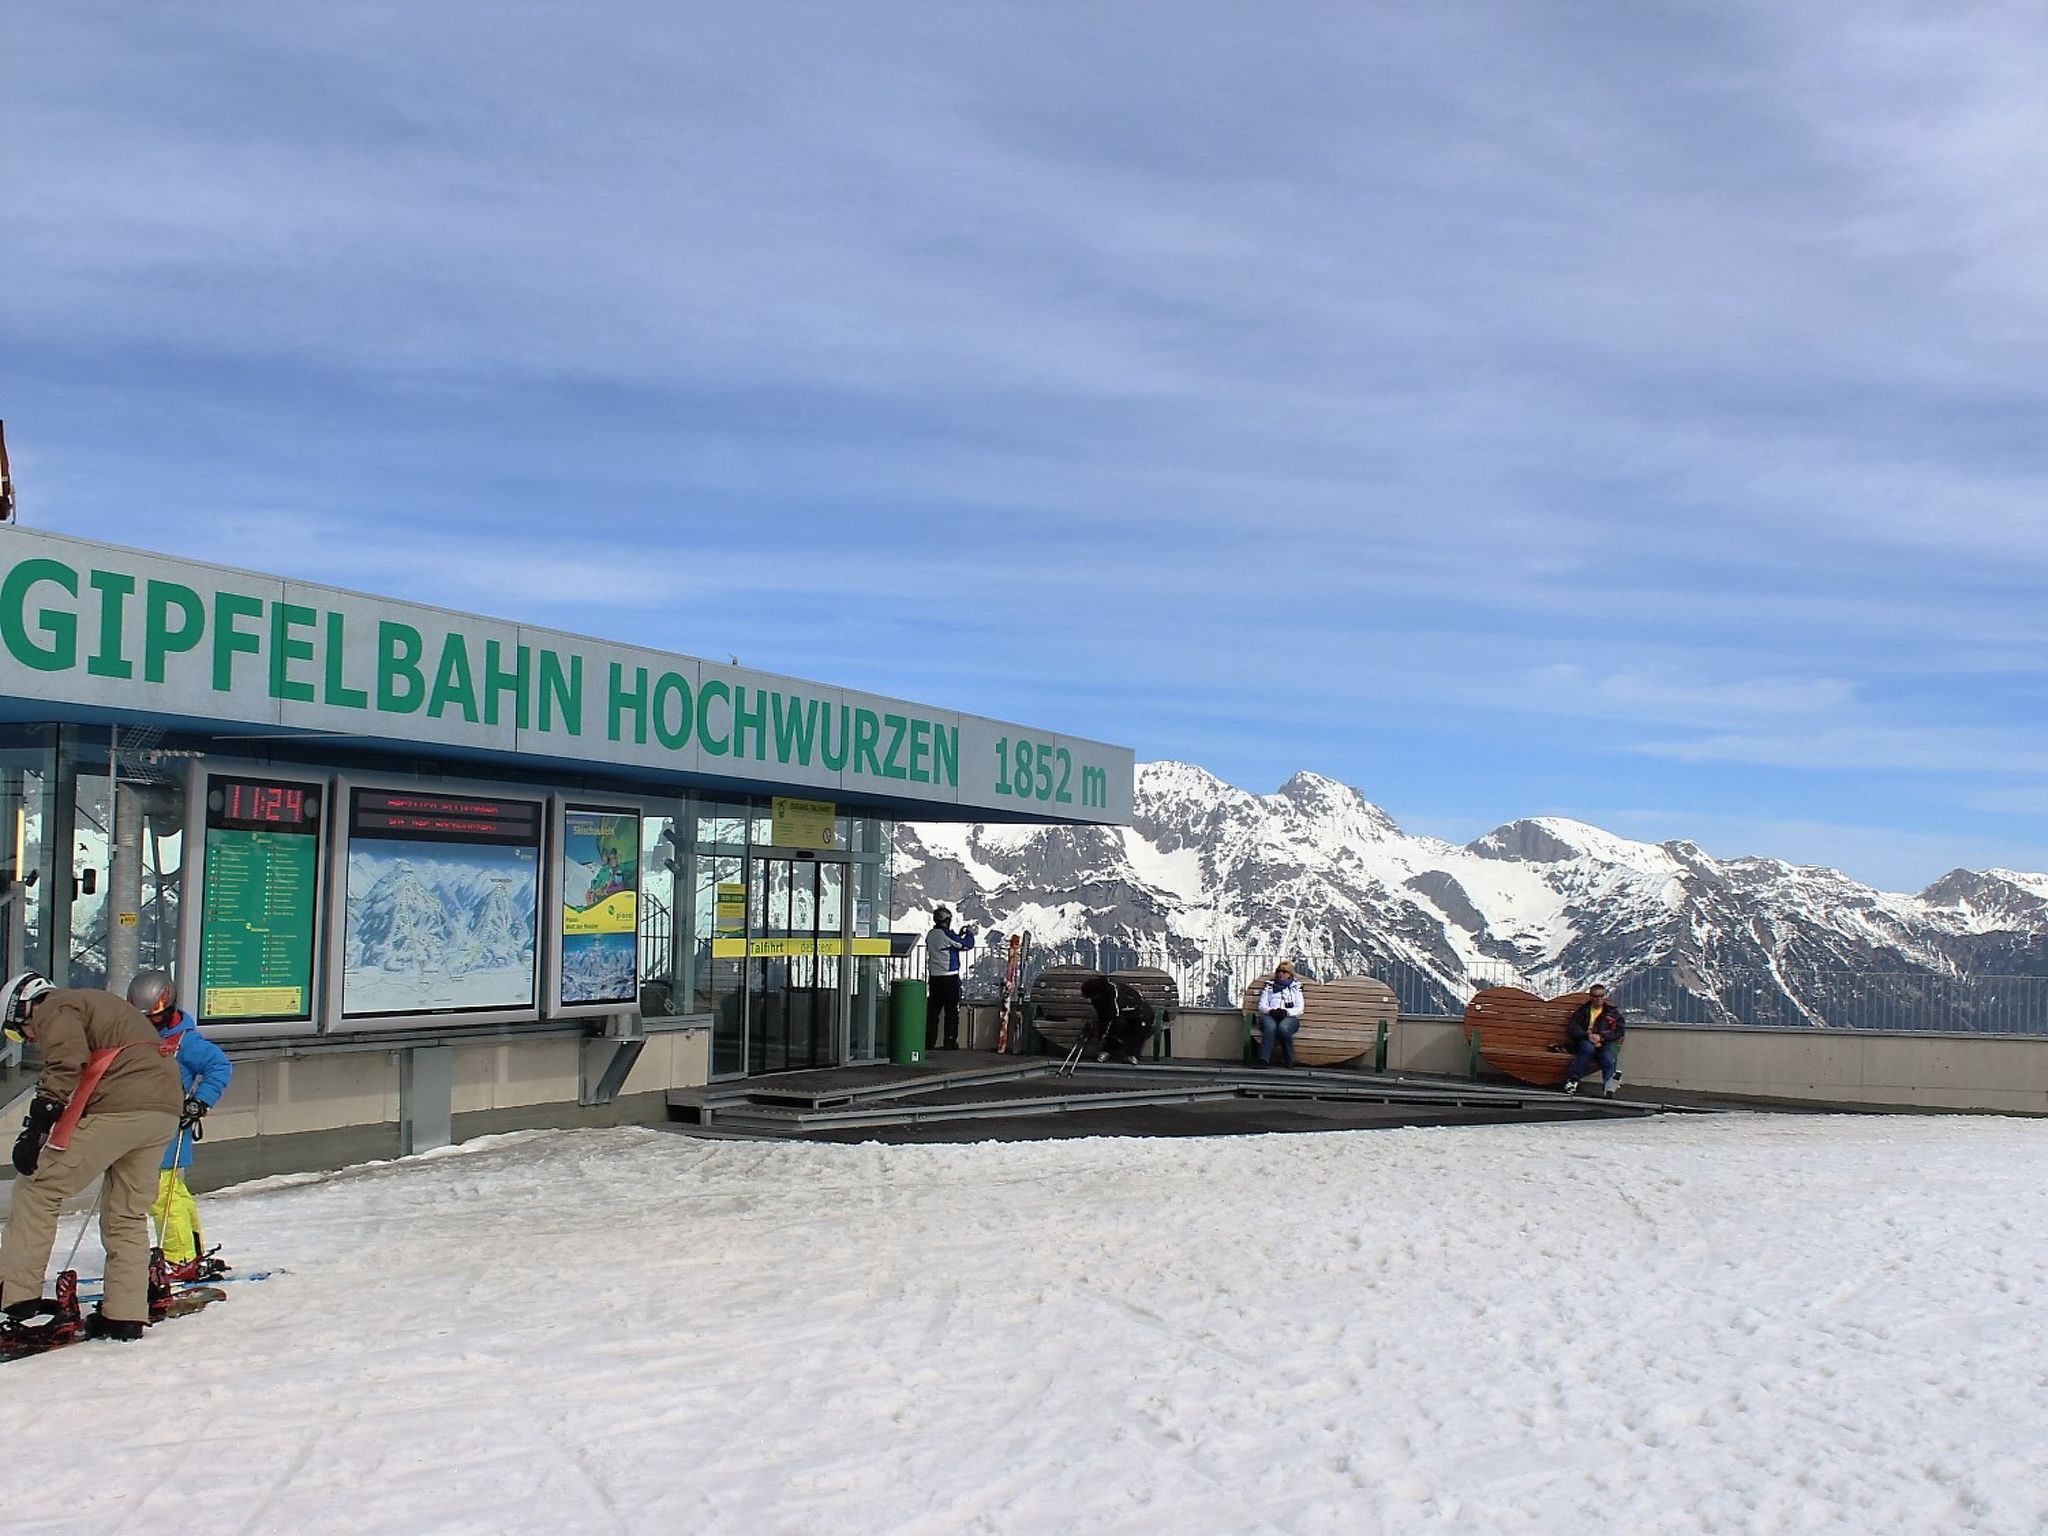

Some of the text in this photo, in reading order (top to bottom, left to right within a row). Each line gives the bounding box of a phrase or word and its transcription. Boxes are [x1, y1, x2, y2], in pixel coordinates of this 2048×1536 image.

[0, 558, 1107, 808] GIPFELBAHN HOCHWURZEN 1852 m
[232, 784, 303, 823] 11:24
